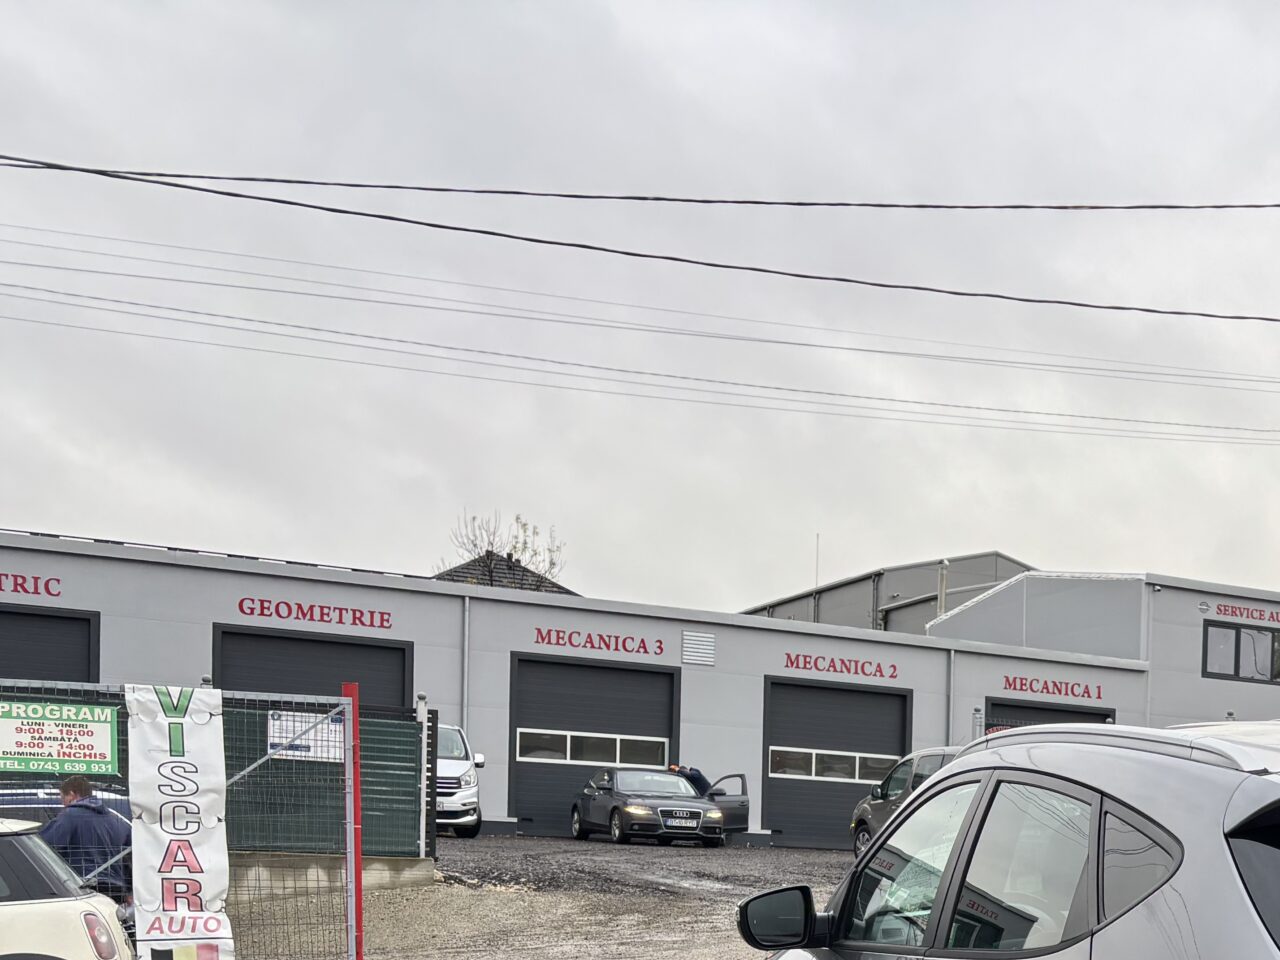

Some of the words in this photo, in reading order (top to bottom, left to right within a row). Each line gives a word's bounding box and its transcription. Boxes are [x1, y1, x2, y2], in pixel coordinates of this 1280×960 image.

[238, 597, 392, 629] GEOMETRIE
[1216, 604, 1265, 620] SERVICE
[534, 627, 649, 654] MECANICA
[654, 639, 664, 655] 3
[784, 653, 885, 678] MECANICA
[889, 664, 898, 679] 2
[1003, 675, 1092, 699] MECANICA
[1096, 685, 1103, 700] 1
[0, 703, 112, 721] PROGRAM
[15, 727, 45, 735] 9:00
[58, 729, 94, 737] 18:00
[15, 741, 45, 749] 9:00
[58, 743, 94, 751] 14:00
[29, 762, 60, 770] 0743
[64, 763, 87, 771] 639
[91, 764, 112, 772] 931
[153, 686, 204, 912] VISCAR
[146, 916, 222, 935] AUTO
